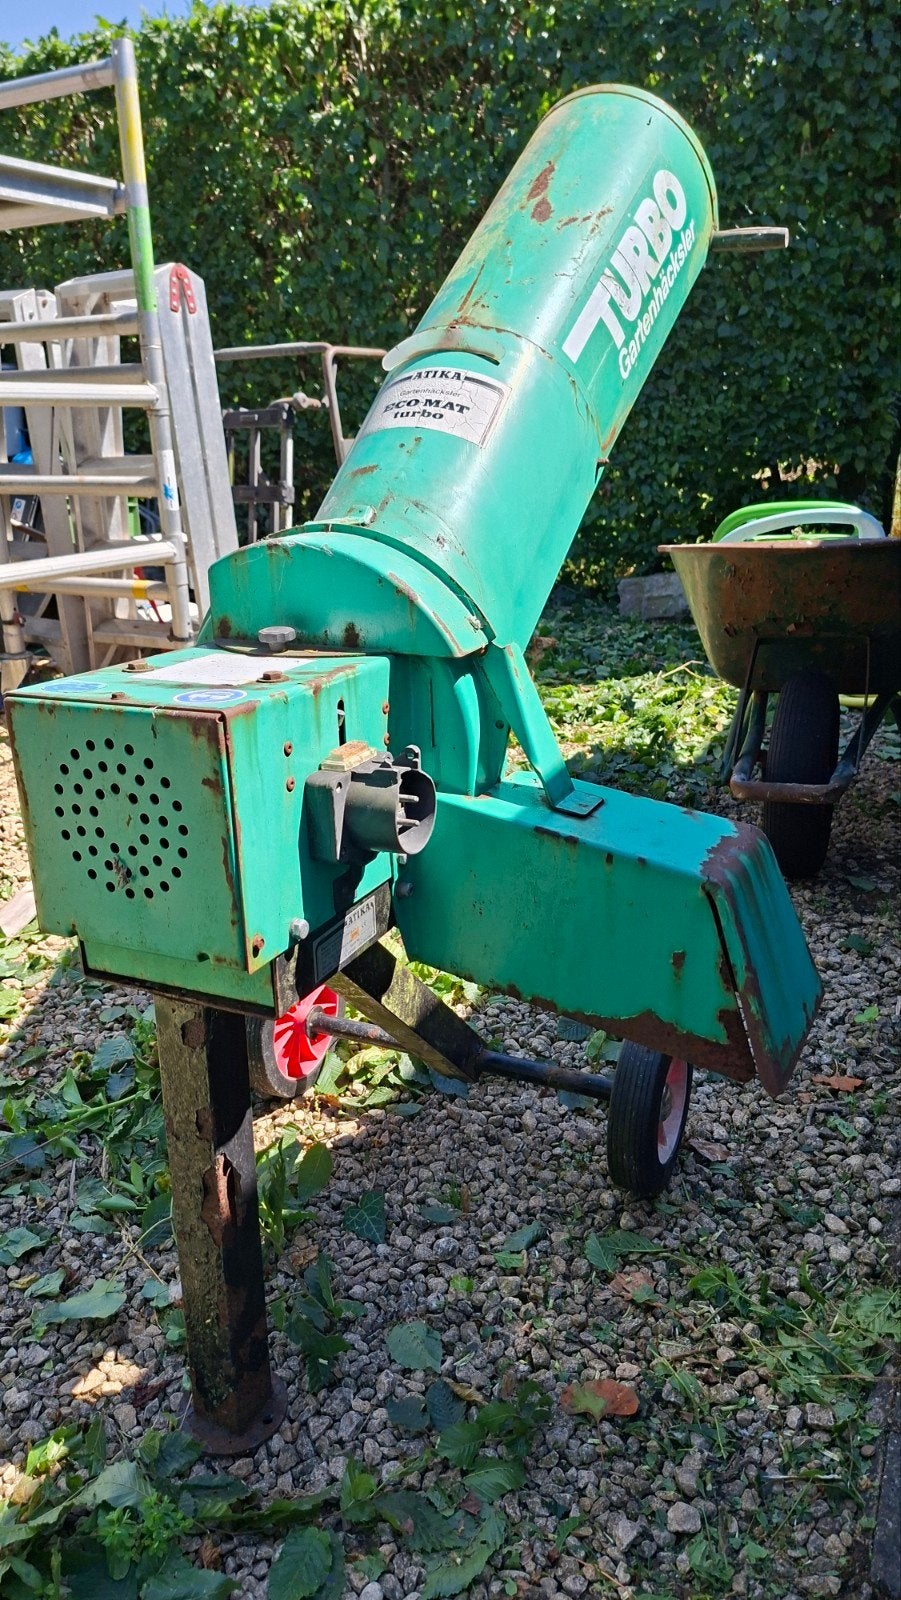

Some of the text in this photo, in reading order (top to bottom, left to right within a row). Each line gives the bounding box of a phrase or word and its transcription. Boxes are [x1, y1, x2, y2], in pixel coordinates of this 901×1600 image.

[562, 169, 687, 364] TURBO
[618, 219, 696, 379] Gartenhäcksler
[393, 409, 444, 420] turbo
[412, 370, 462, 381] ATIKA
